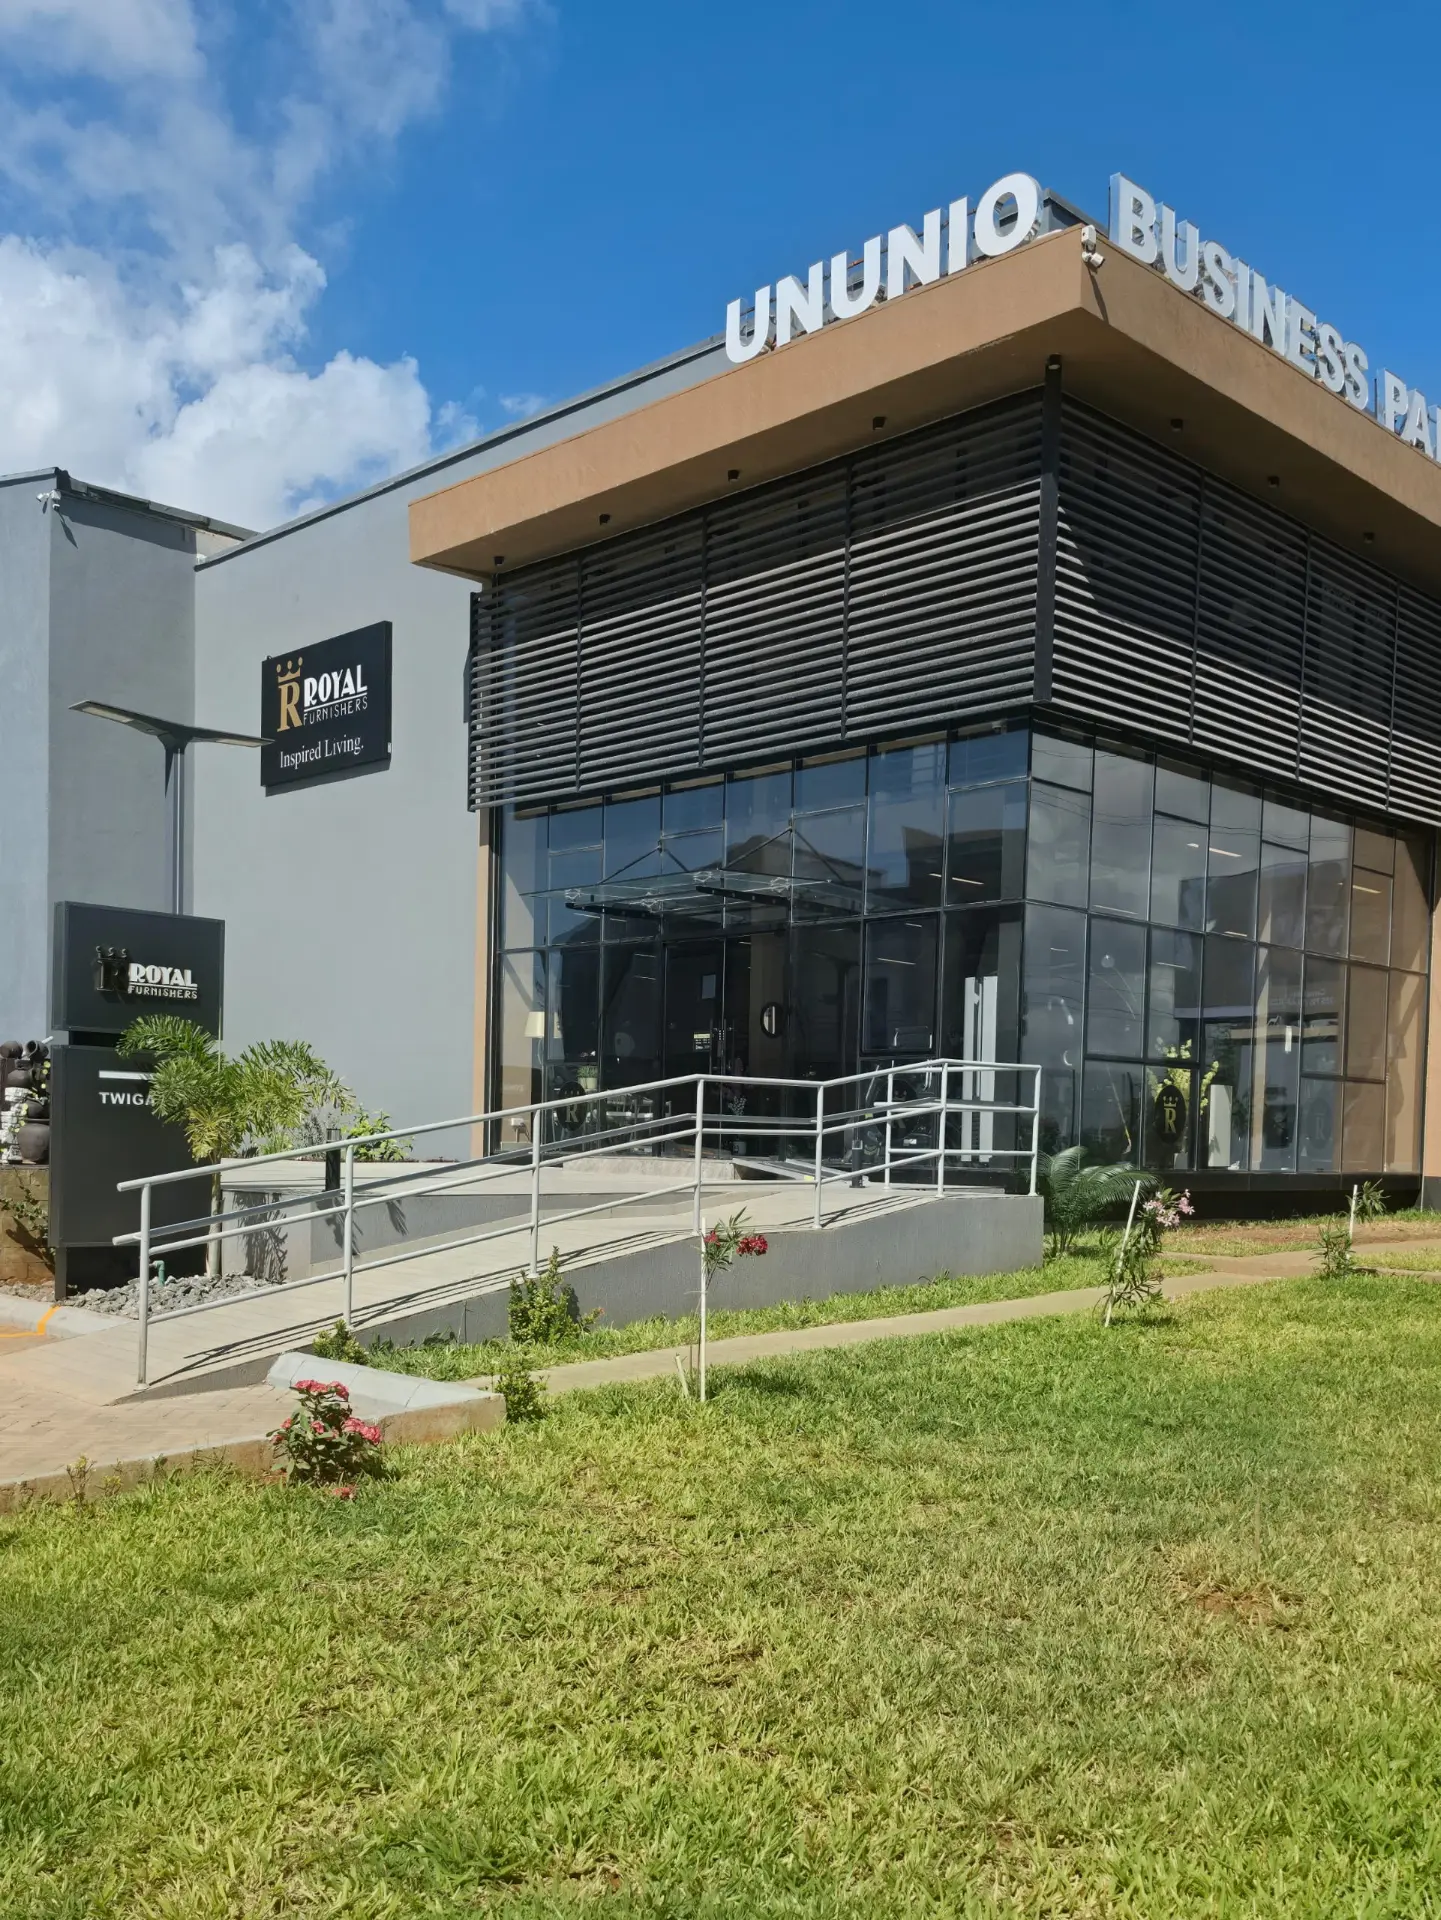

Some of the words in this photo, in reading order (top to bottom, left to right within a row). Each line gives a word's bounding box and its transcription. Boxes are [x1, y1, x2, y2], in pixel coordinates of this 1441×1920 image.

[725, 172, 1043, 364] UNUNIO
[1110, 172, 1369, 411] BUSINESS
[1376, 367, 1441, 464] PA
[303, 664, 368, 708] ROYAL
[303, 696, 368, 726] FURNISHERS
[280, 741, 322, 770] Inspired
[324, 734, 364, 756] Living.
[128, 962, 198, 988] ROYAL
[127, 985, 198, 1000] FURNISHERS
[1163, 1107, 1177, 1134] R
